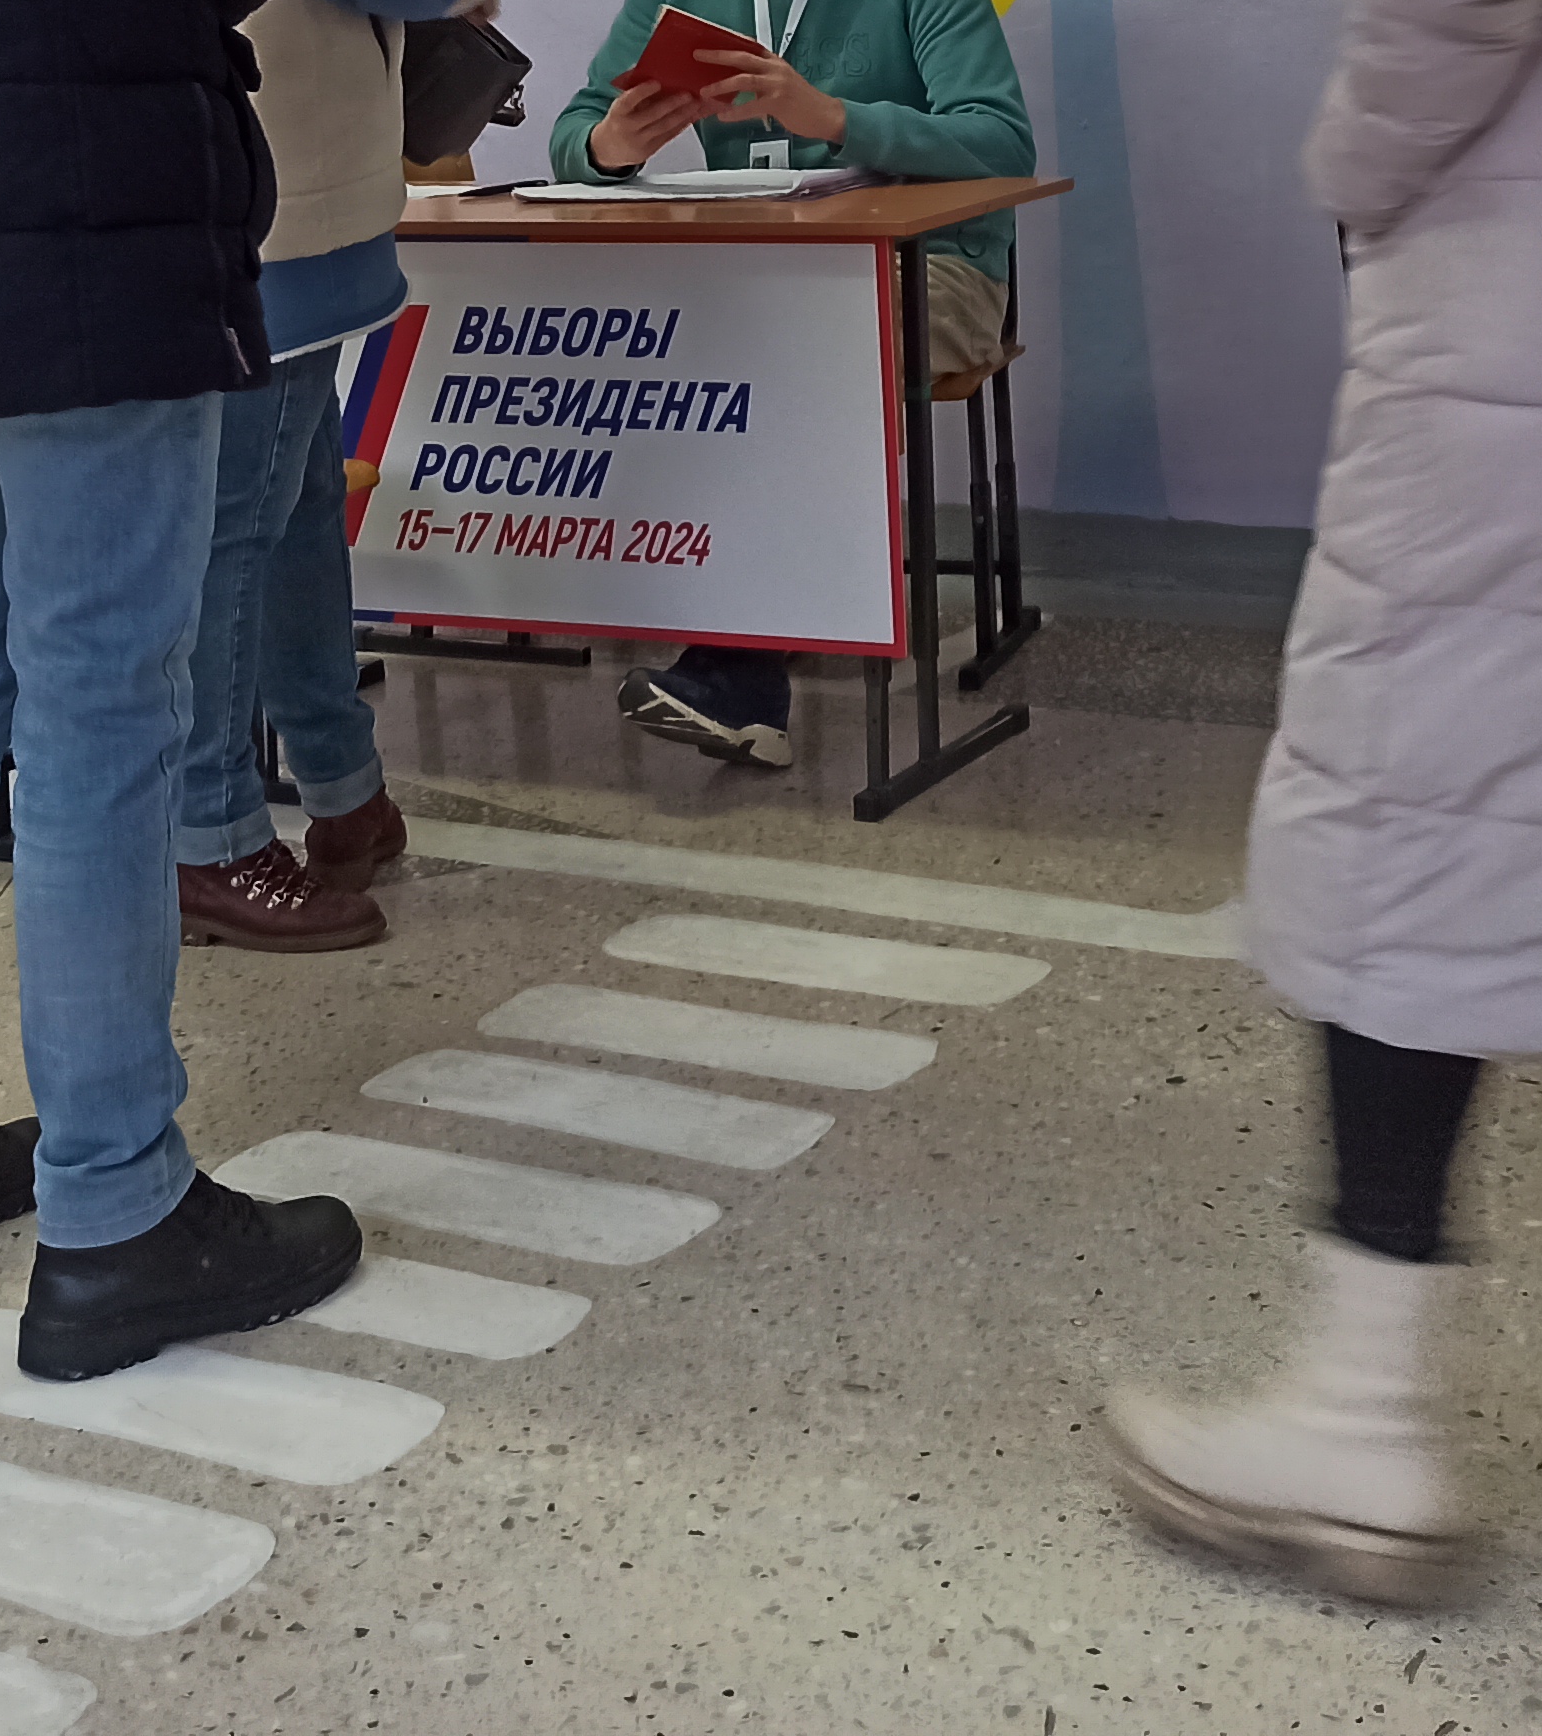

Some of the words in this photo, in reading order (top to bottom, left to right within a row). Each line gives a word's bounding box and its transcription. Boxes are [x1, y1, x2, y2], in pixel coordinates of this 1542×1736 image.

[452, 305, 681, 359] ВЫБОРЫ
[430, 374, 751, 437] ПРЕЗИДЕНТА
[409, 443, 613, 500] РОССИИ
[395, 508, 494, 554] 15–17
[493, 513, 615, 562] МАРТА
[620, 519, 711, 567] 2024
